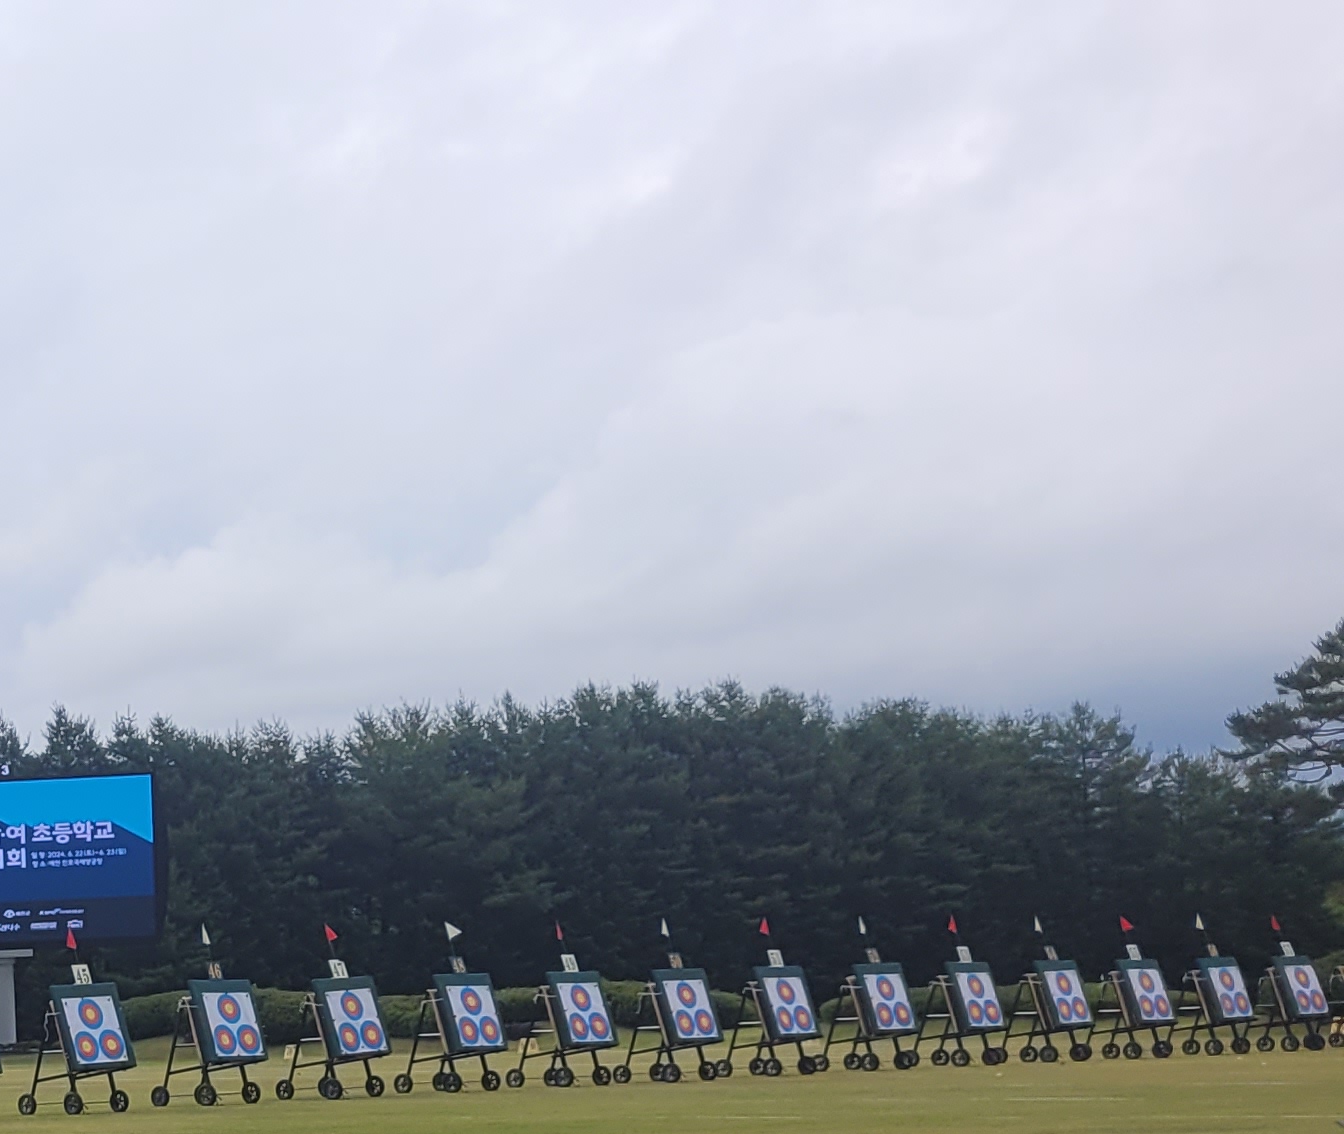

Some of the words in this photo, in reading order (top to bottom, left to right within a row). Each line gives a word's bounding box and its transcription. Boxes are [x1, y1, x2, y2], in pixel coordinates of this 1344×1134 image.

[31, 821, 115, 844] 초등학교
[75, 967, 91, 984] 45
[208, 963, 222, 979] 46
[333, 961, 347, 978] 47
